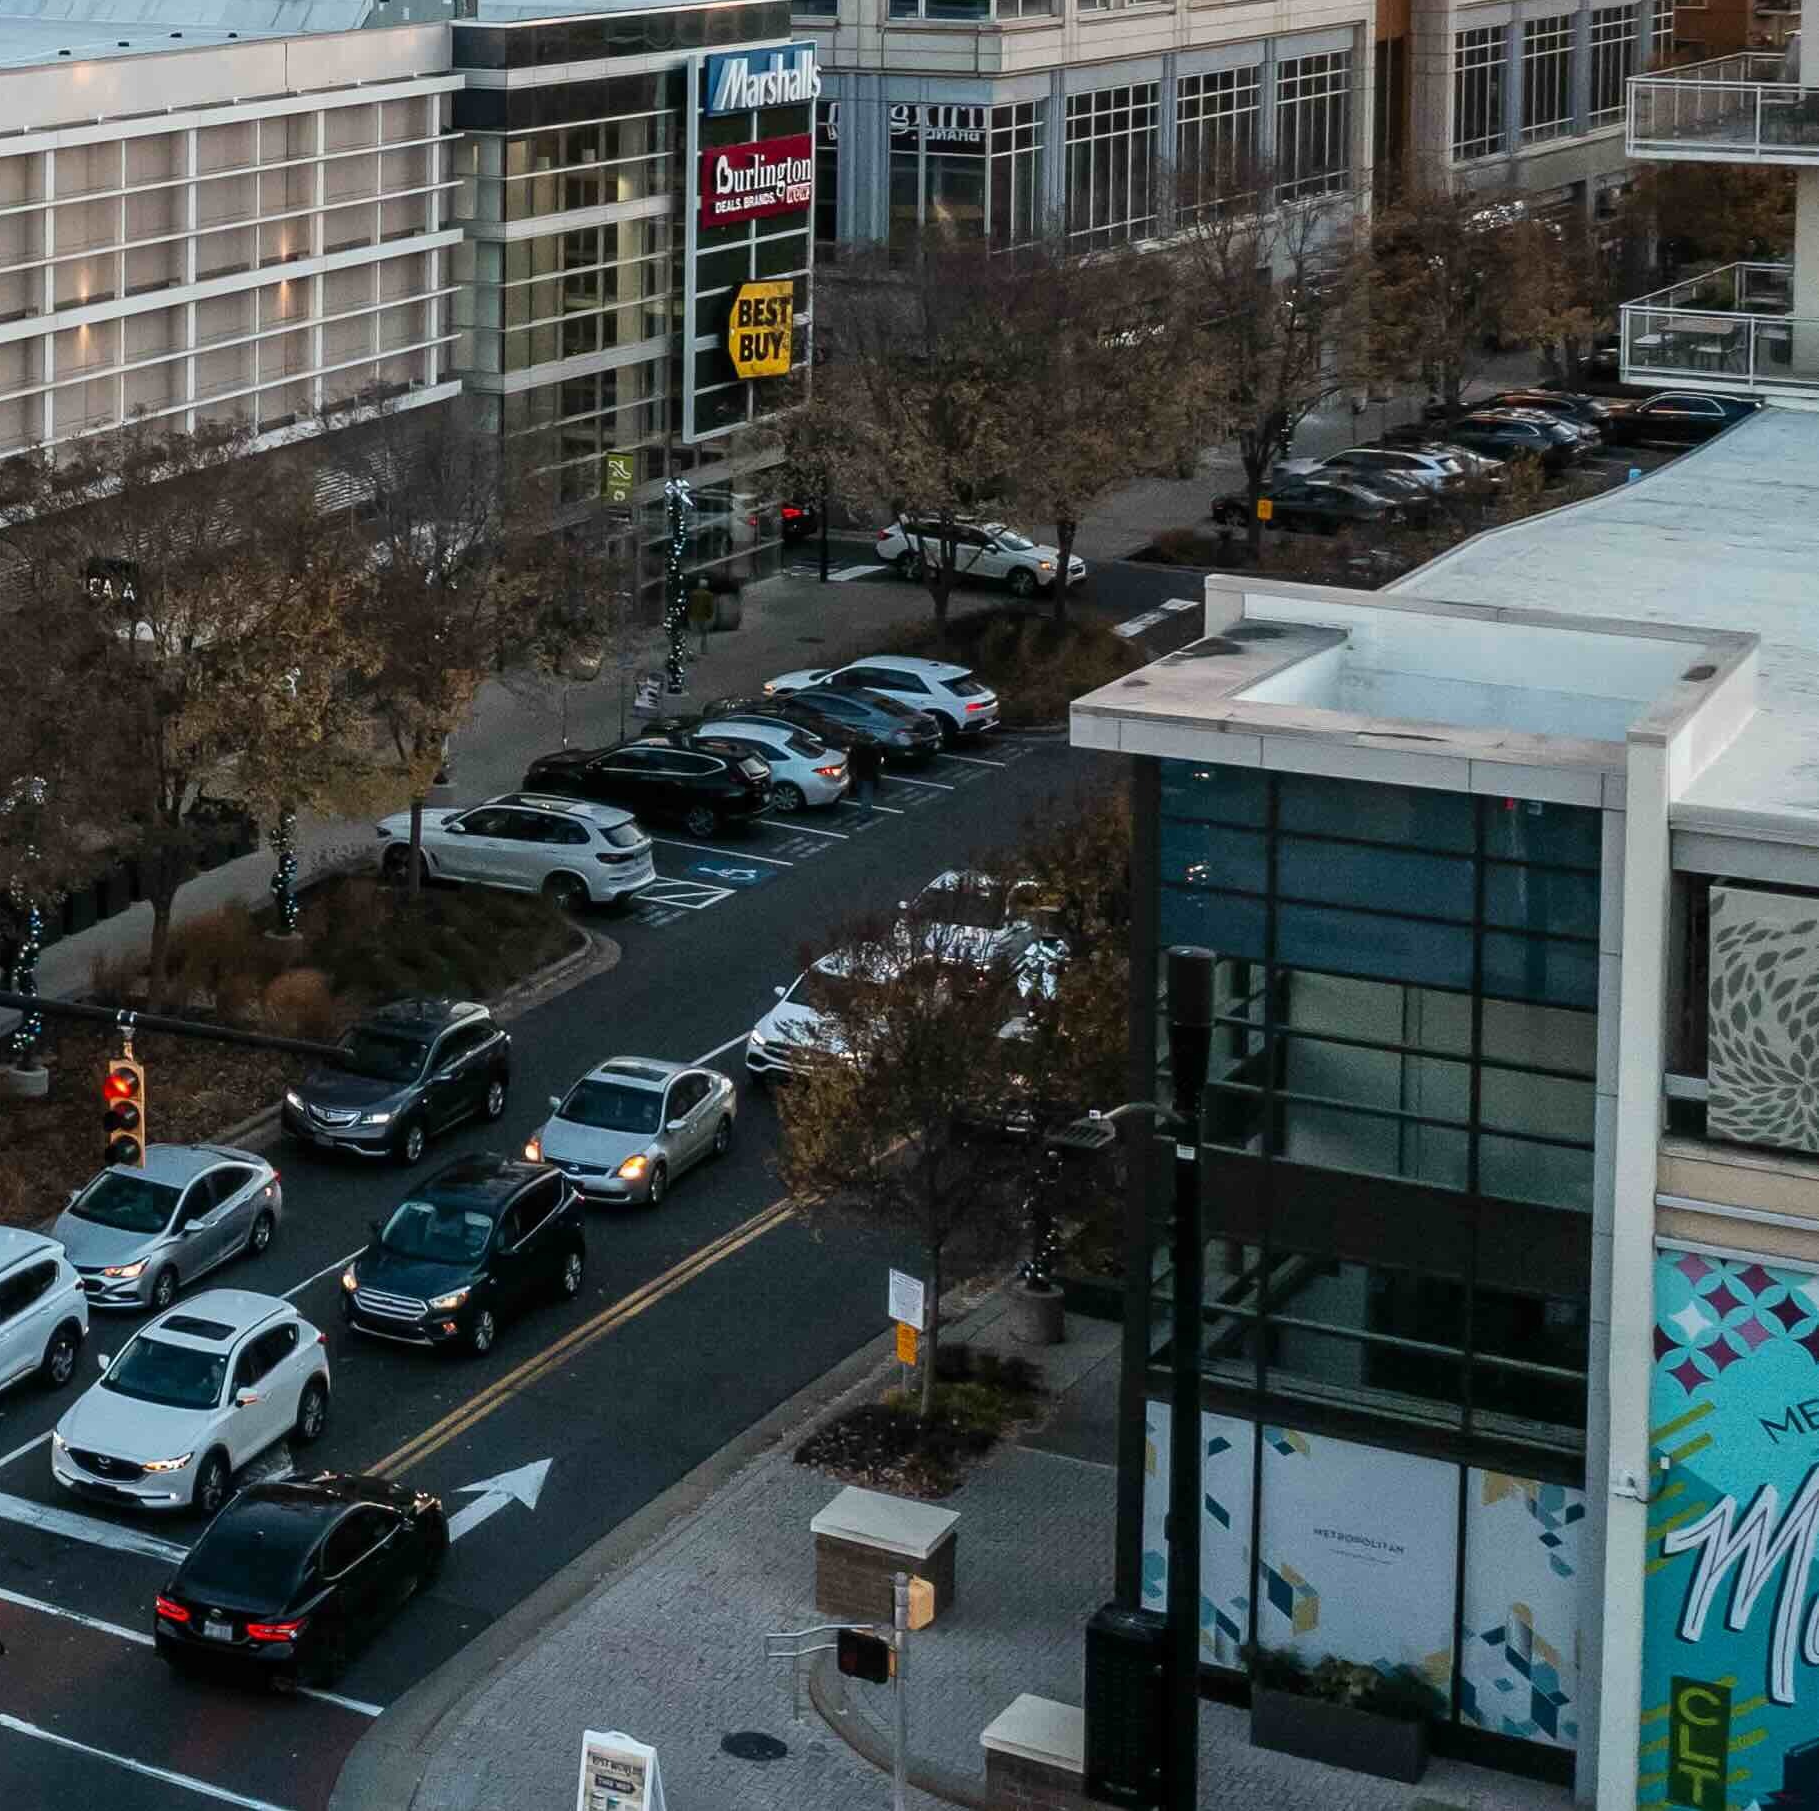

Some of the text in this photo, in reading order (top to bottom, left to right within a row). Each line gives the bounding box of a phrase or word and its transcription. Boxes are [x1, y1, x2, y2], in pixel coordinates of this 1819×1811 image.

[713, 50, 821, 110] Marshalls
[716, 155, 811, 197] Burlington
[715, 197, 742, 214] DEALS.
[744, 191, 776, 209] BRANDS.
[738, 296, 793, 327] BEST
[739, 333, 785, 362] BUY
[1677, 1687, 1721, 1806] CLT
